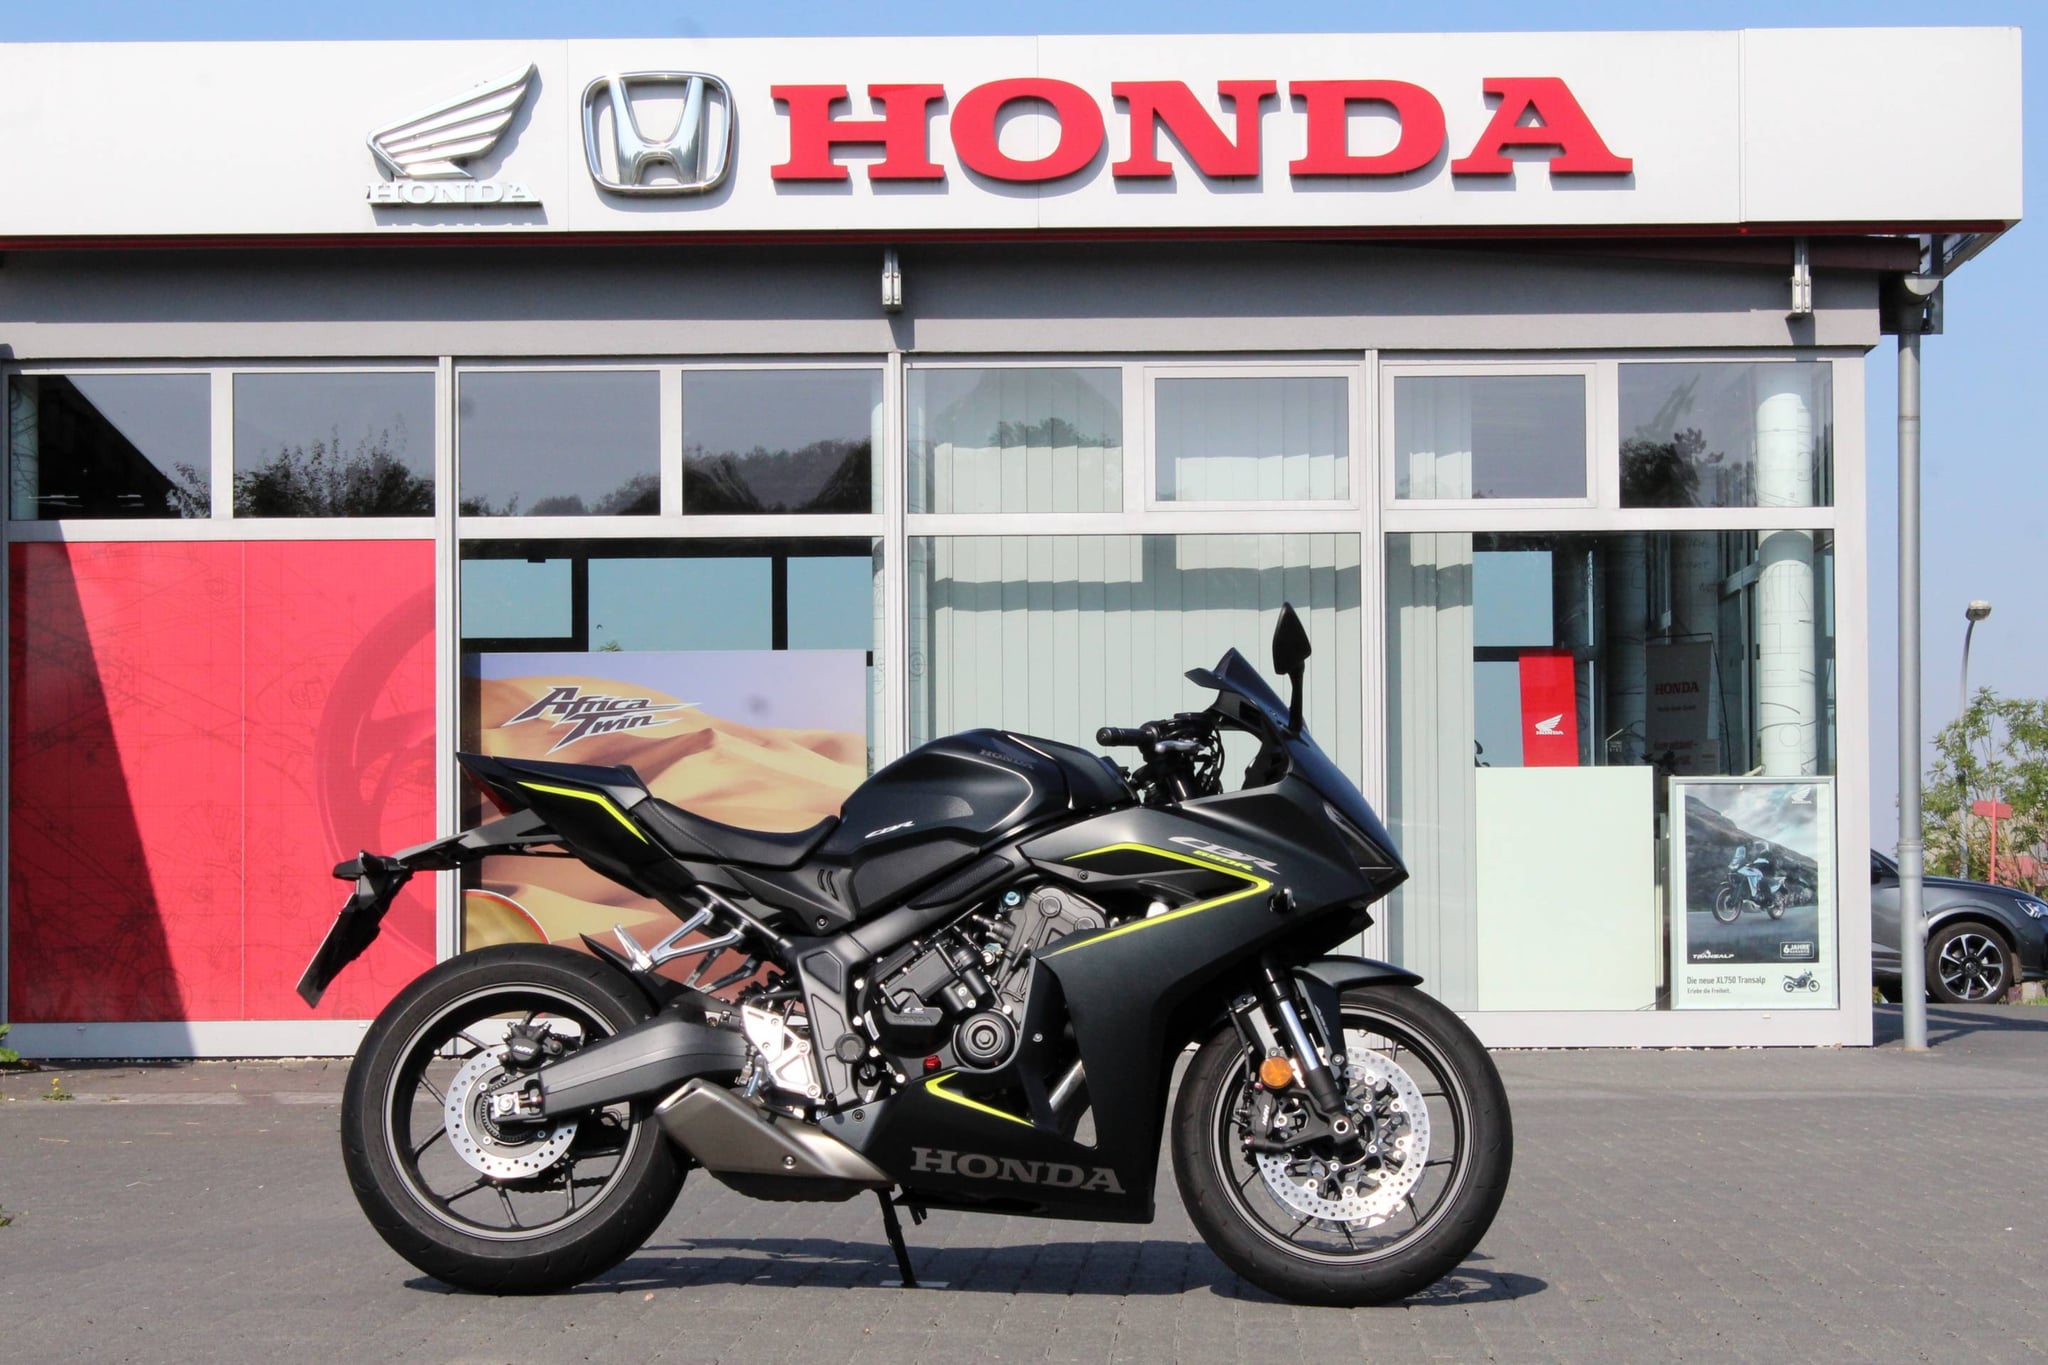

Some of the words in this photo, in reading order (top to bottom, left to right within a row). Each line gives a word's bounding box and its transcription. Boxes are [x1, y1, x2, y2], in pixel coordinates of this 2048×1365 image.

[770, 76, 1634, 182] HONDA
[366, 181, 541, 206] HONDA
[1654, 681, 1700, 696] HONDA
[501, 685, 702, 728] Africa
[544, 712, 682, 757] Twin
[979, 748, 1035, 771] HONDA
[1168, 836, 1281, 876] CBR
[1192, 850, 1254, 872] 650R
[1686, 976, 1697, 985] Die
[1716, 976, 1736, 985] XL750
[1738, 976, 1766, 985] Transalp
[910, 1146, 1127, 1195] HONDA
